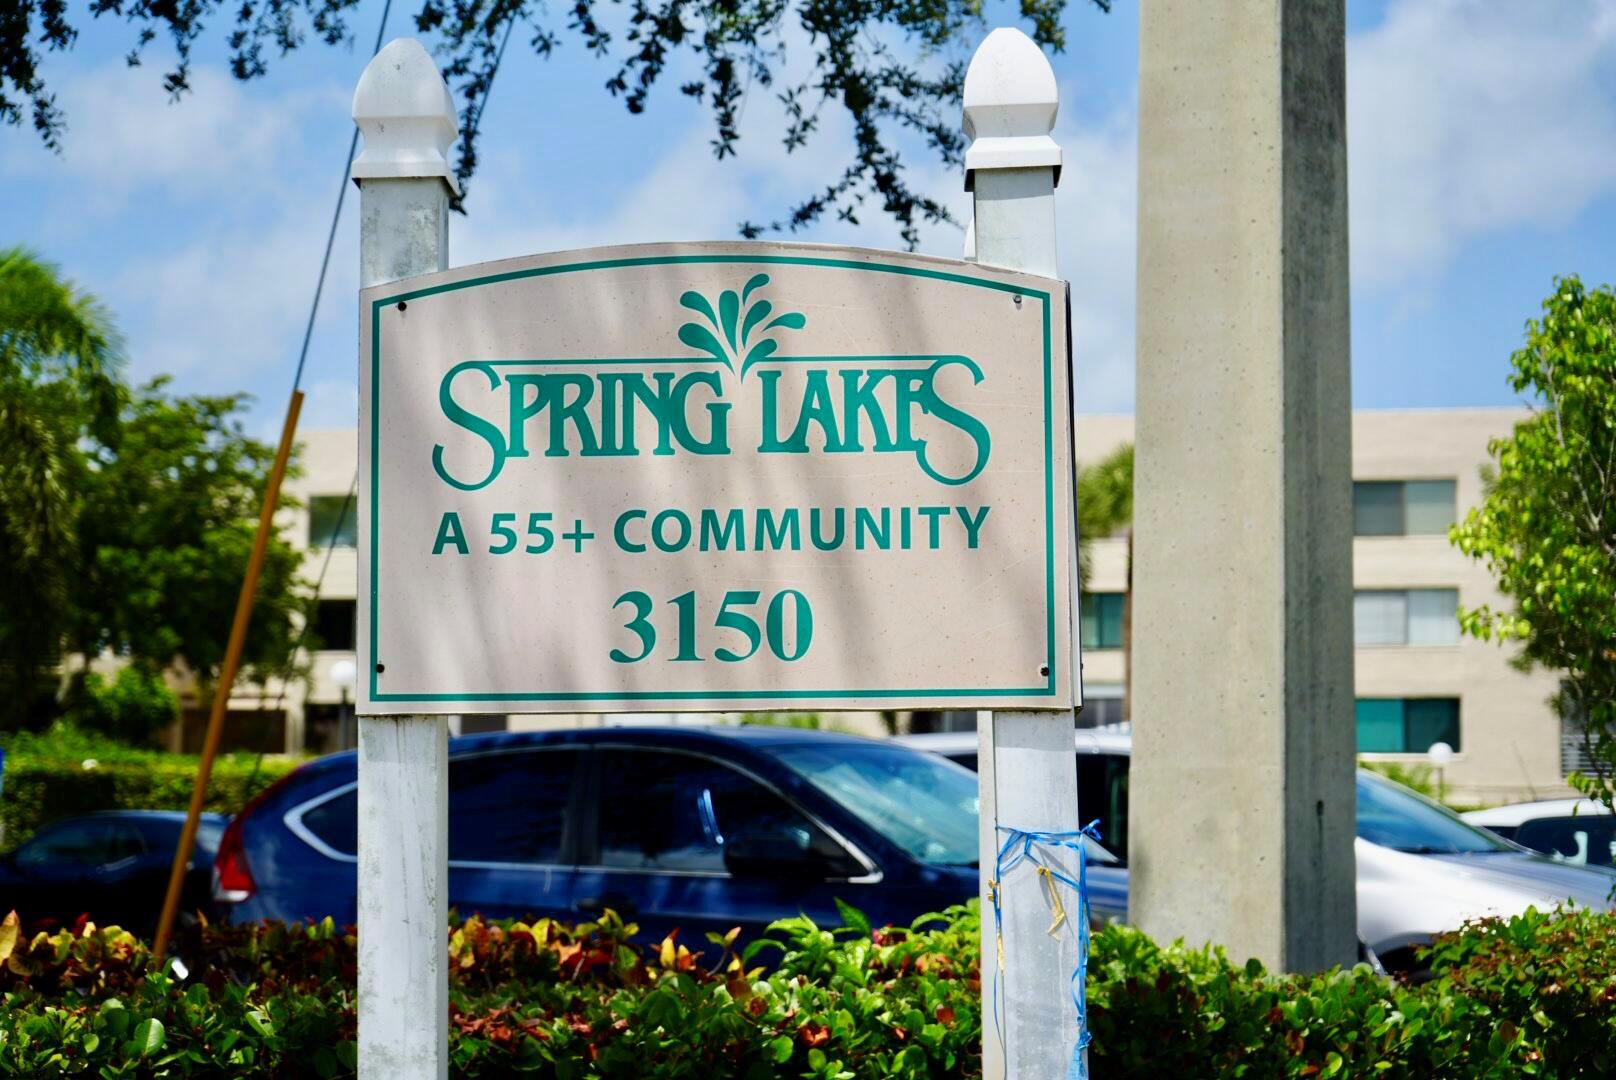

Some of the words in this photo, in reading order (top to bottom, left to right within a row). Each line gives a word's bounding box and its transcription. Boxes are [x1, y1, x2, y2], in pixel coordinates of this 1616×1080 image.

[432, 360, 732, 491] SPRING
[757, 355, 991, 486] LAKES
[432, 511, 470, 555] A
[489, 511, 595, 555] 55+
[613, 506, 991, 554] COMMUNITY
[609, 589, 814, 664] 3150
